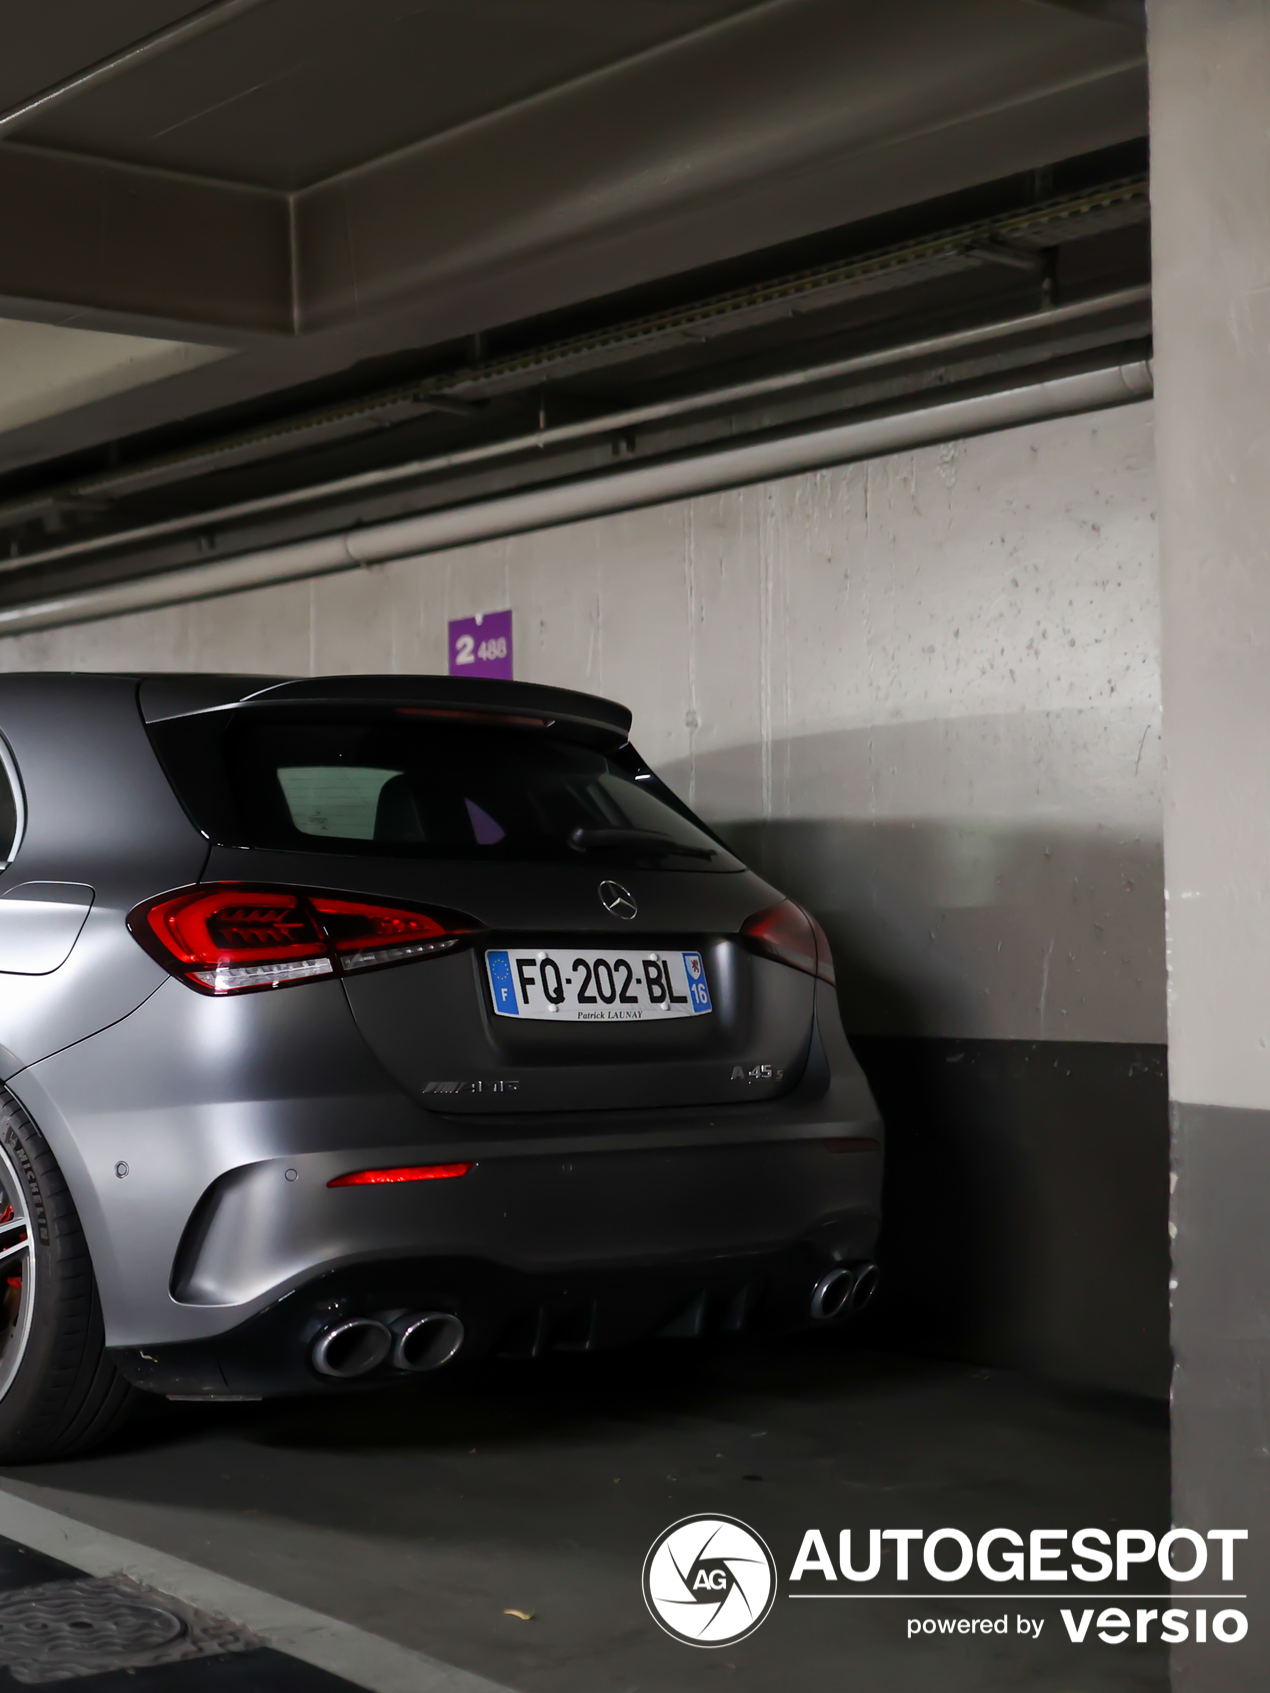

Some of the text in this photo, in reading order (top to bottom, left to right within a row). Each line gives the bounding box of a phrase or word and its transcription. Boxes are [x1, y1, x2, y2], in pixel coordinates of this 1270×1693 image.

[456, 634, 507, 665] 2 488
[515, 957, 688, 1005] FQ-202-BL
[501, 988, 508, 1002] F
[691, 982, 707, 1005] 16
[577, 1010, 643, 1019] Patrick LAUNAY
[731, 1065, 745, 1080] A
[748, 1064, 772, 1079] 45
[16, 1148, 49, 1241] MICHELIN
